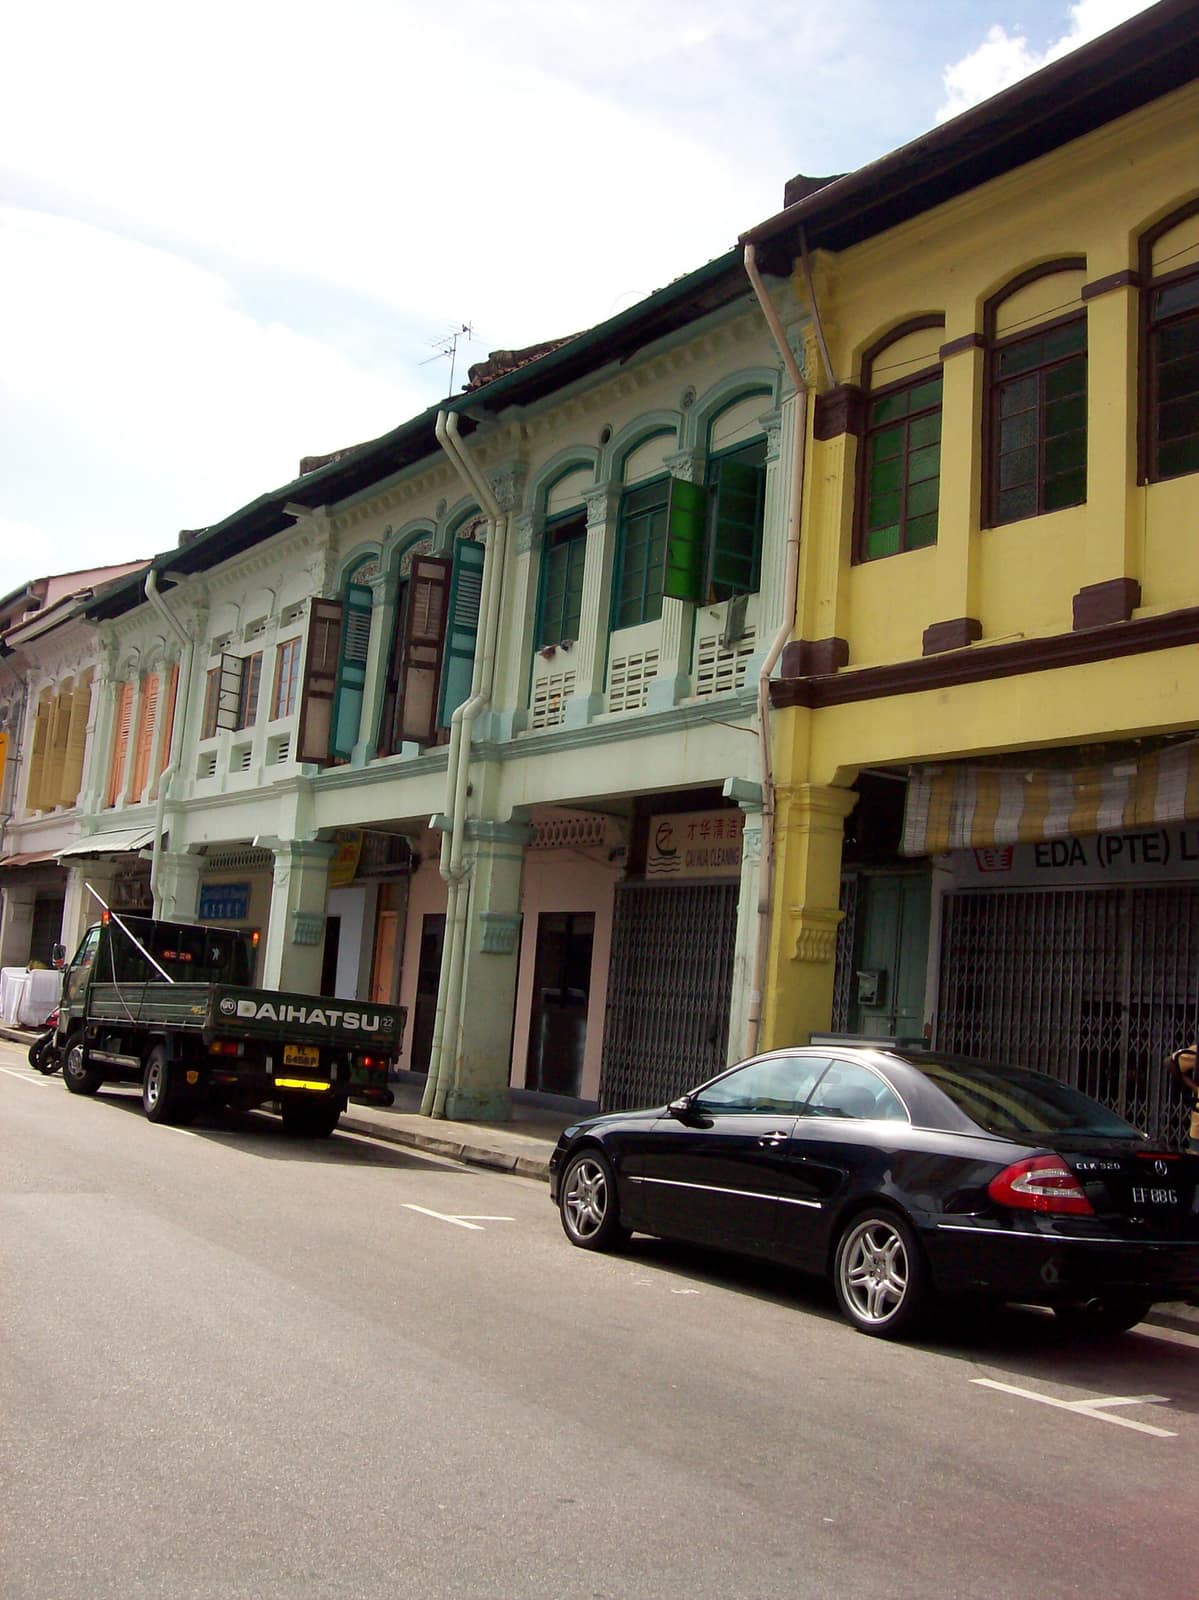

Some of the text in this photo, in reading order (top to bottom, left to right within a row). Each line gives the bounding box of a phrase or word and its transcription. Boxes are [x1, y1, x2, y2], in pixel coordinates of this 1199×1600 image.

[687, 815, 744, 840] 才华清洁
[1034, 829, 1199, 868] EDA (PTE) L
[236, 999, 380, 1032] DAIHATSU
[1075, 1161, 1097, 1171] CLK
